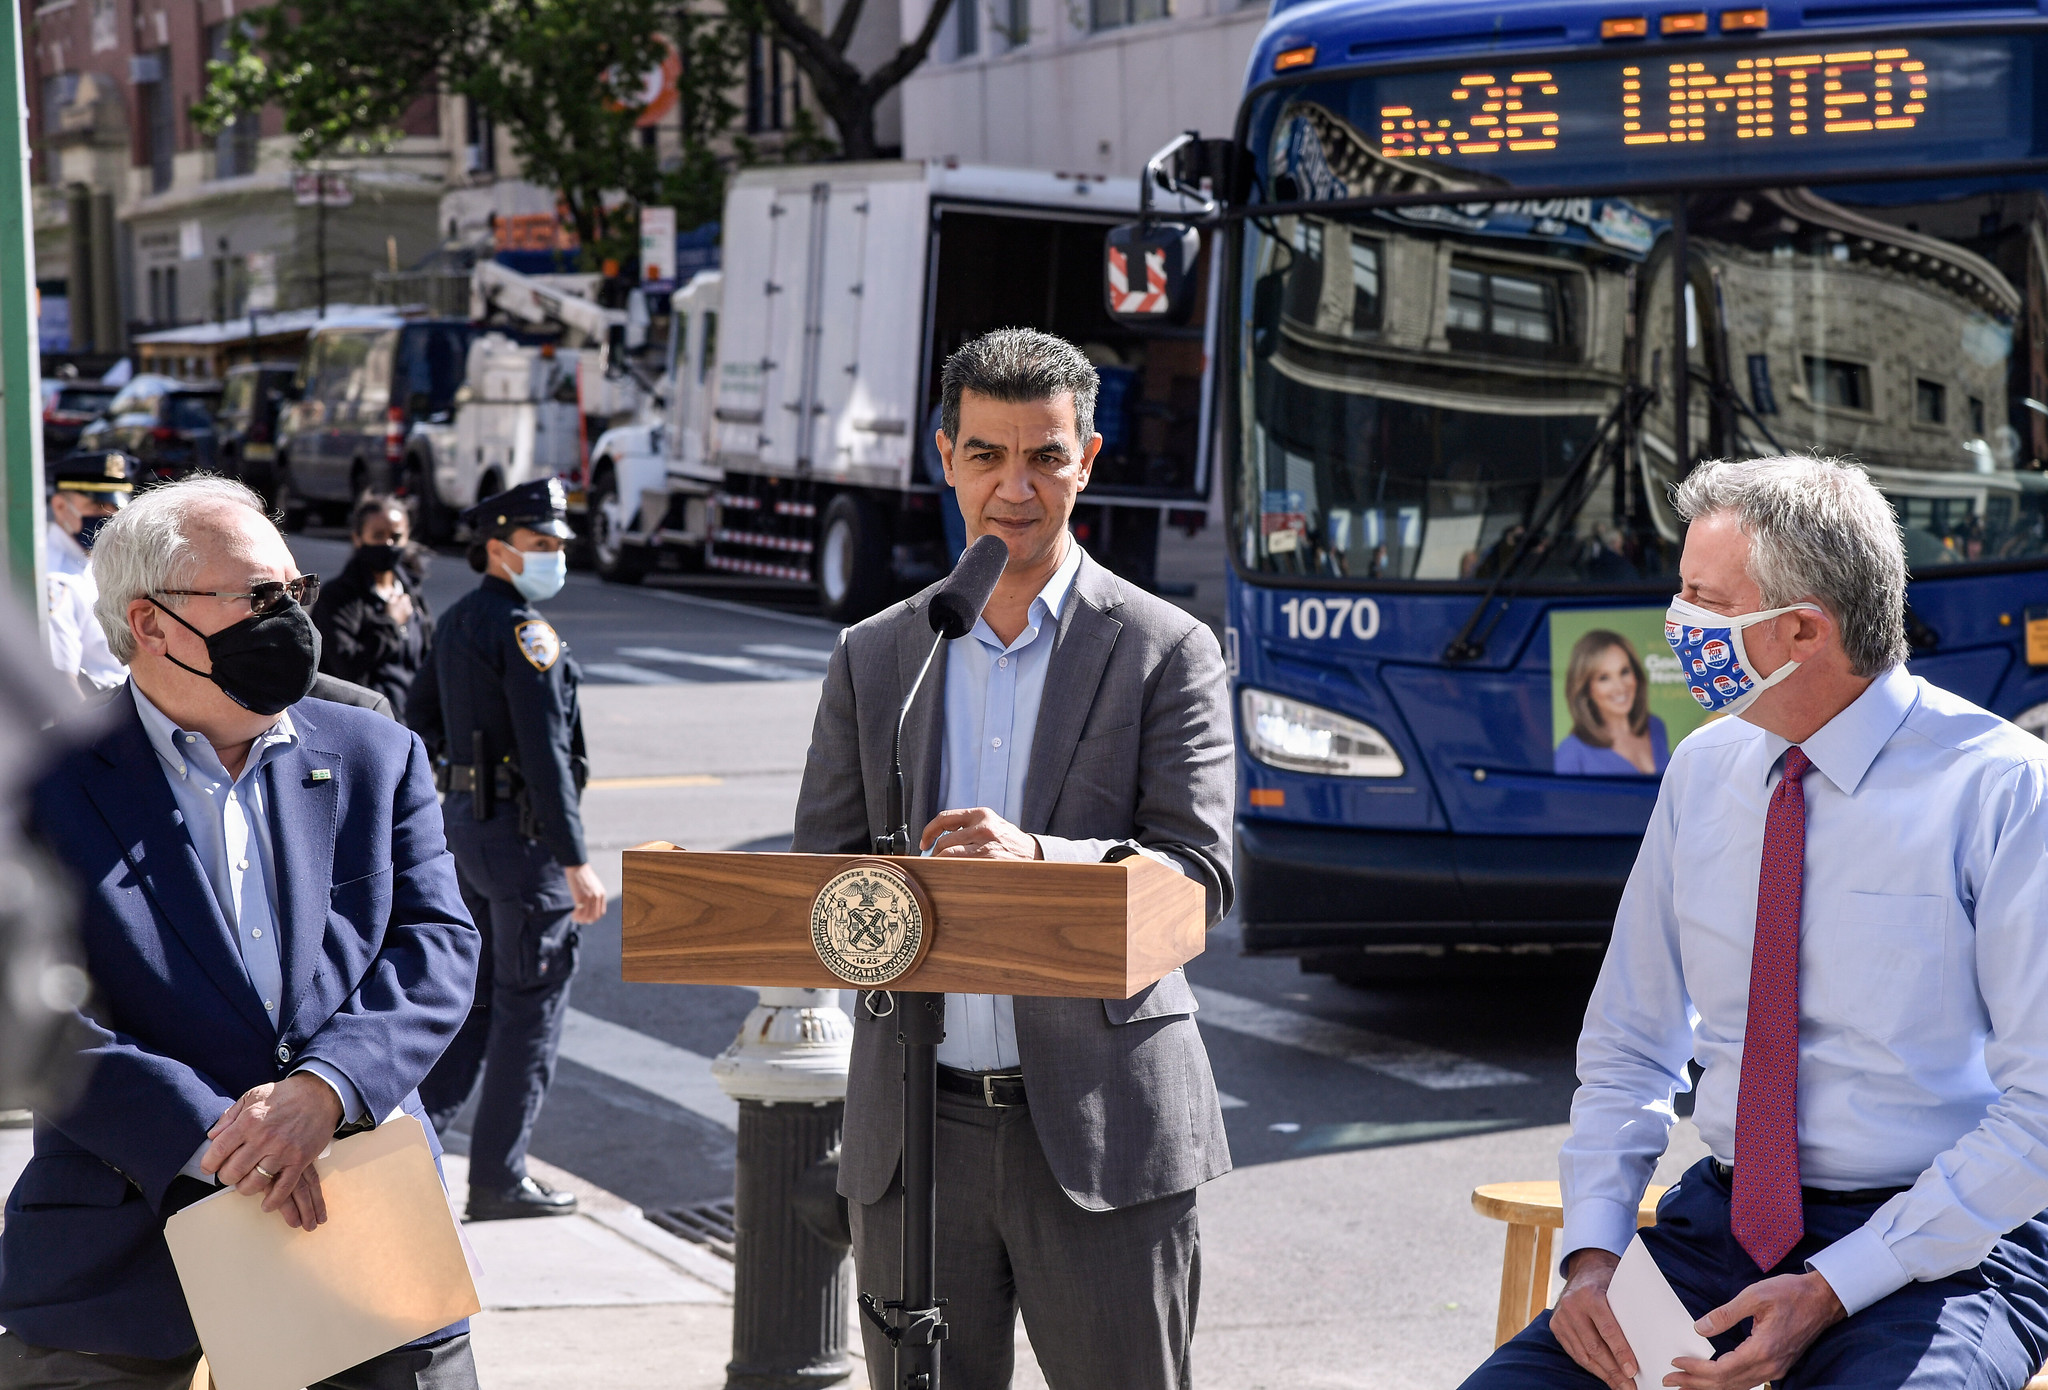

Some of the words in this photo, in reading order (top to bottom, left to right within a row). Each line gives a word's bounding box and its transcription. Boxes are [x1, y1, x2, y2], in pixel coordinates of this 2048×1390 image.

[1381, 71, 1559, 157] Bx36
[1623, 48, 1928, 145] LIMITED
[1280, 598, 1380, 641] 1070
[1708, 647, 1722, 656] VOTE
[1709, 653, 1723, 661] NYC
[834, 956, 881, 978] CIVITATIS
[855, 957, 878, 965] 1625
